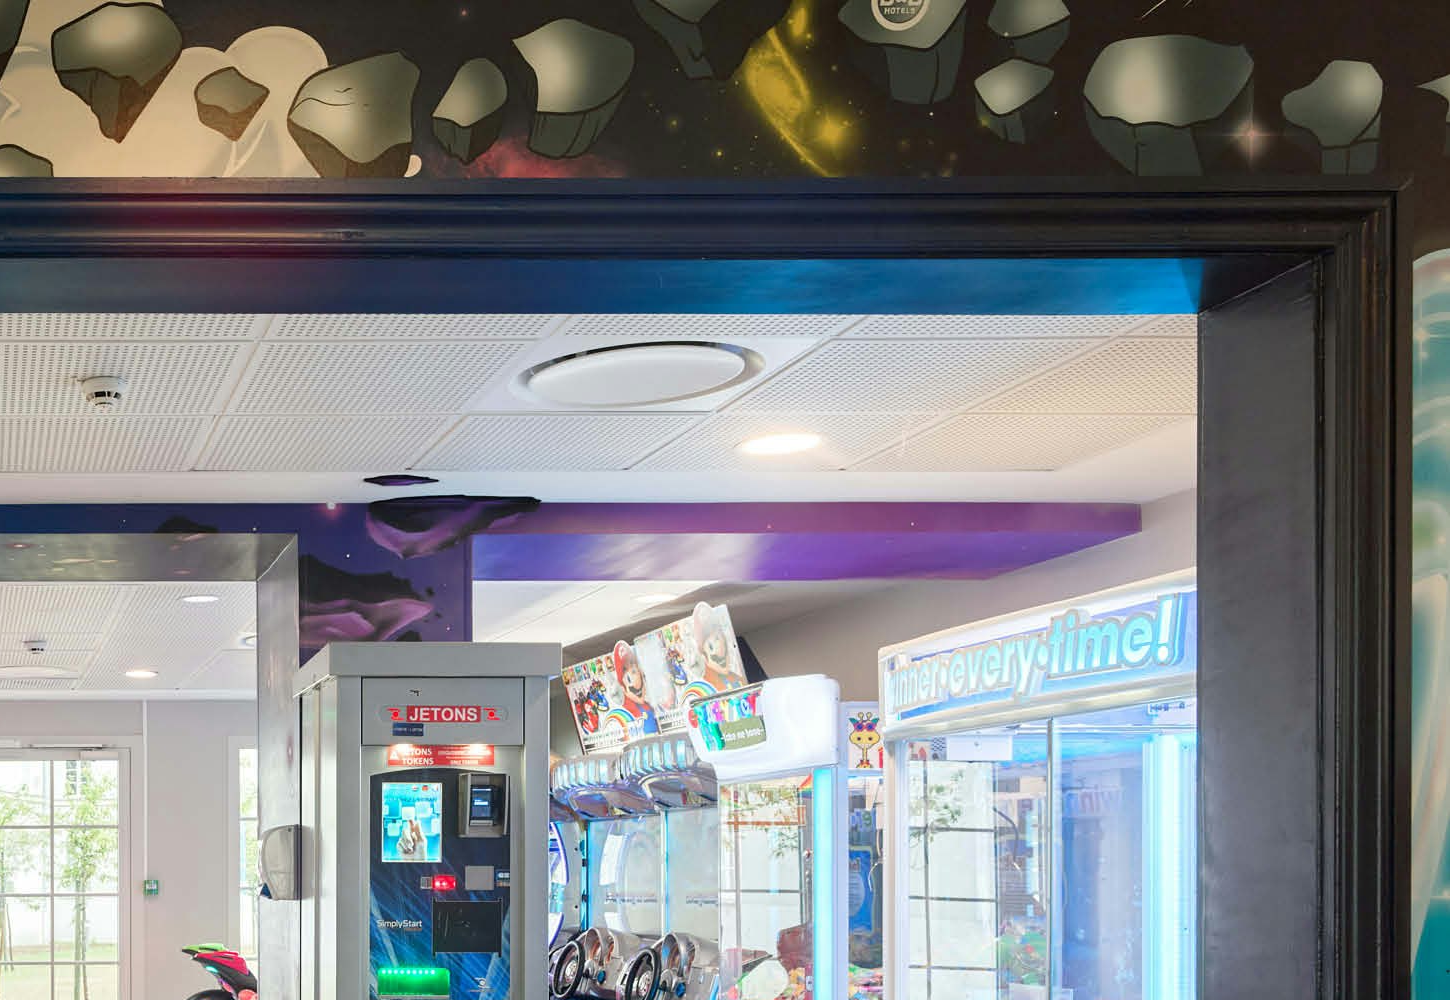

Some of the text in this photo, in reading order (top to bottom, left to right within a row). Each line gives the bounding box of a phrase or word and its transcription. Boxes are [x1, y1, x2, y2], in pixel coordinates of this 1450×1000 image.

[884, 7, 916, 15] HOTELS
[1050, 598, 1174, 673] time!
[409, 707, 478, 721] JETONS
[402, 757, 434, 765] TOKENS
[376, 919, 423, 929] SimplyStart
